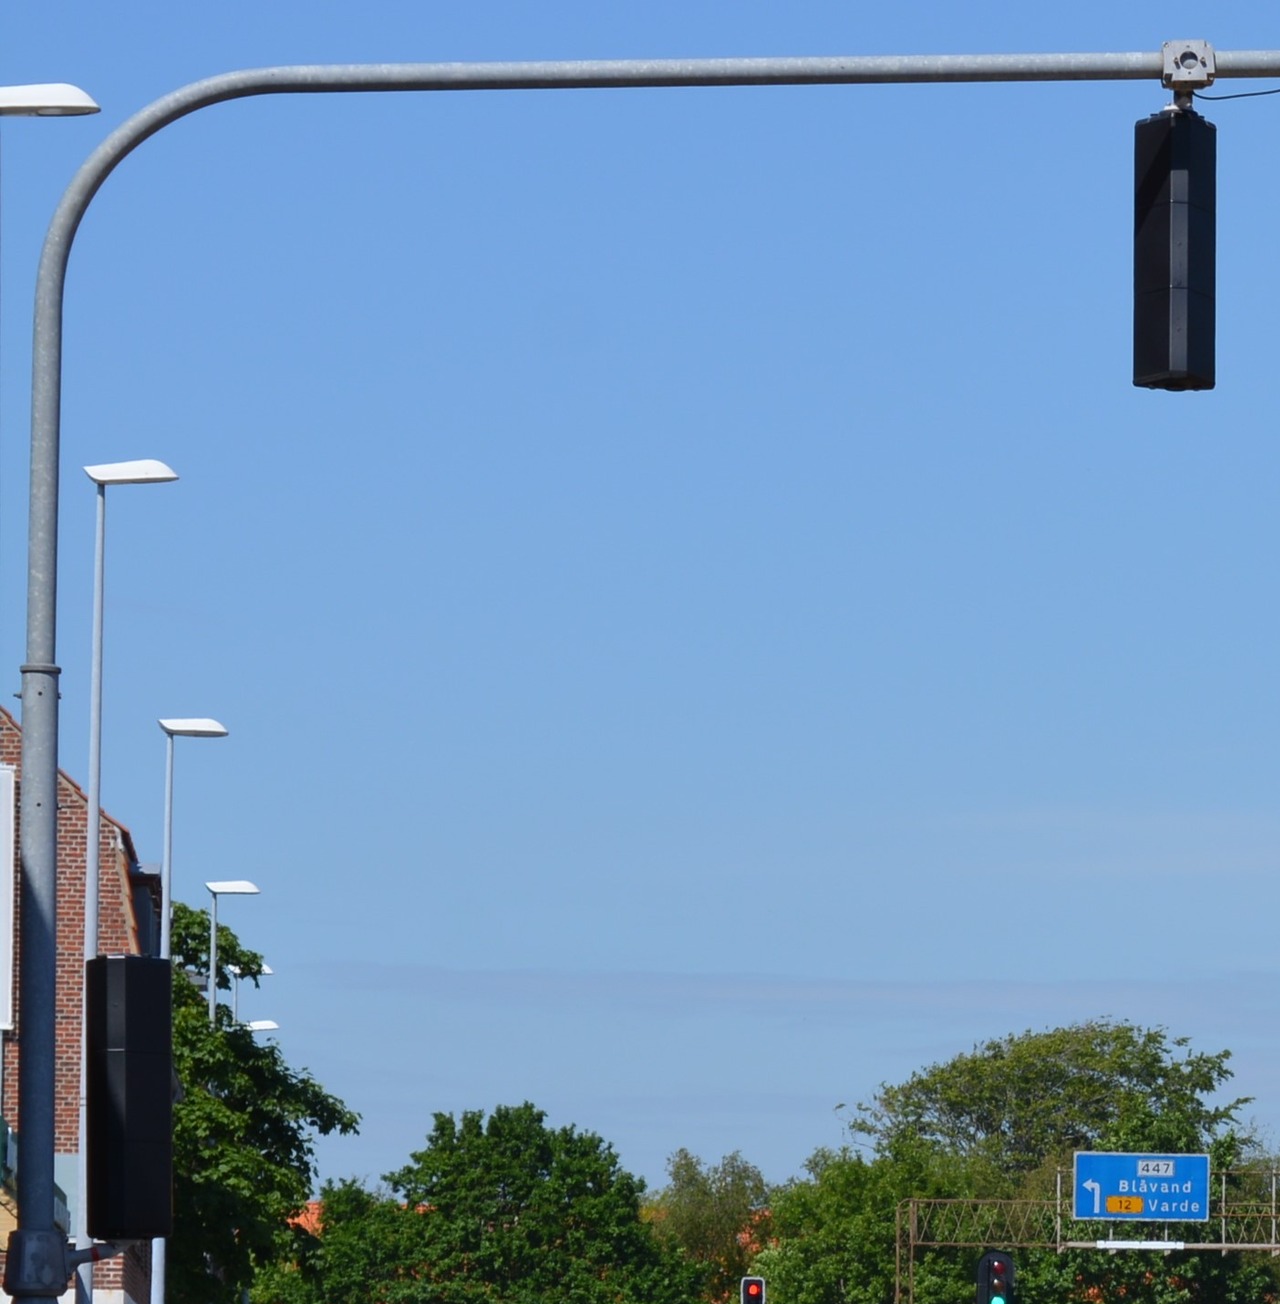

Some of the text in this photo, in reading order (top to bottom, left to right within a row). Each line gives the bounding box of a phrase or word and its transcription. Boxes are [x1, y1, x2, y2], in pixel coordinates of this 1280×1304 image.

[1141, 1163, 1171, 1174] 447
[1119, 1179, 1192, 1193] Blåvand
[1118, 1199, 1200, 1213] 12 Varde
